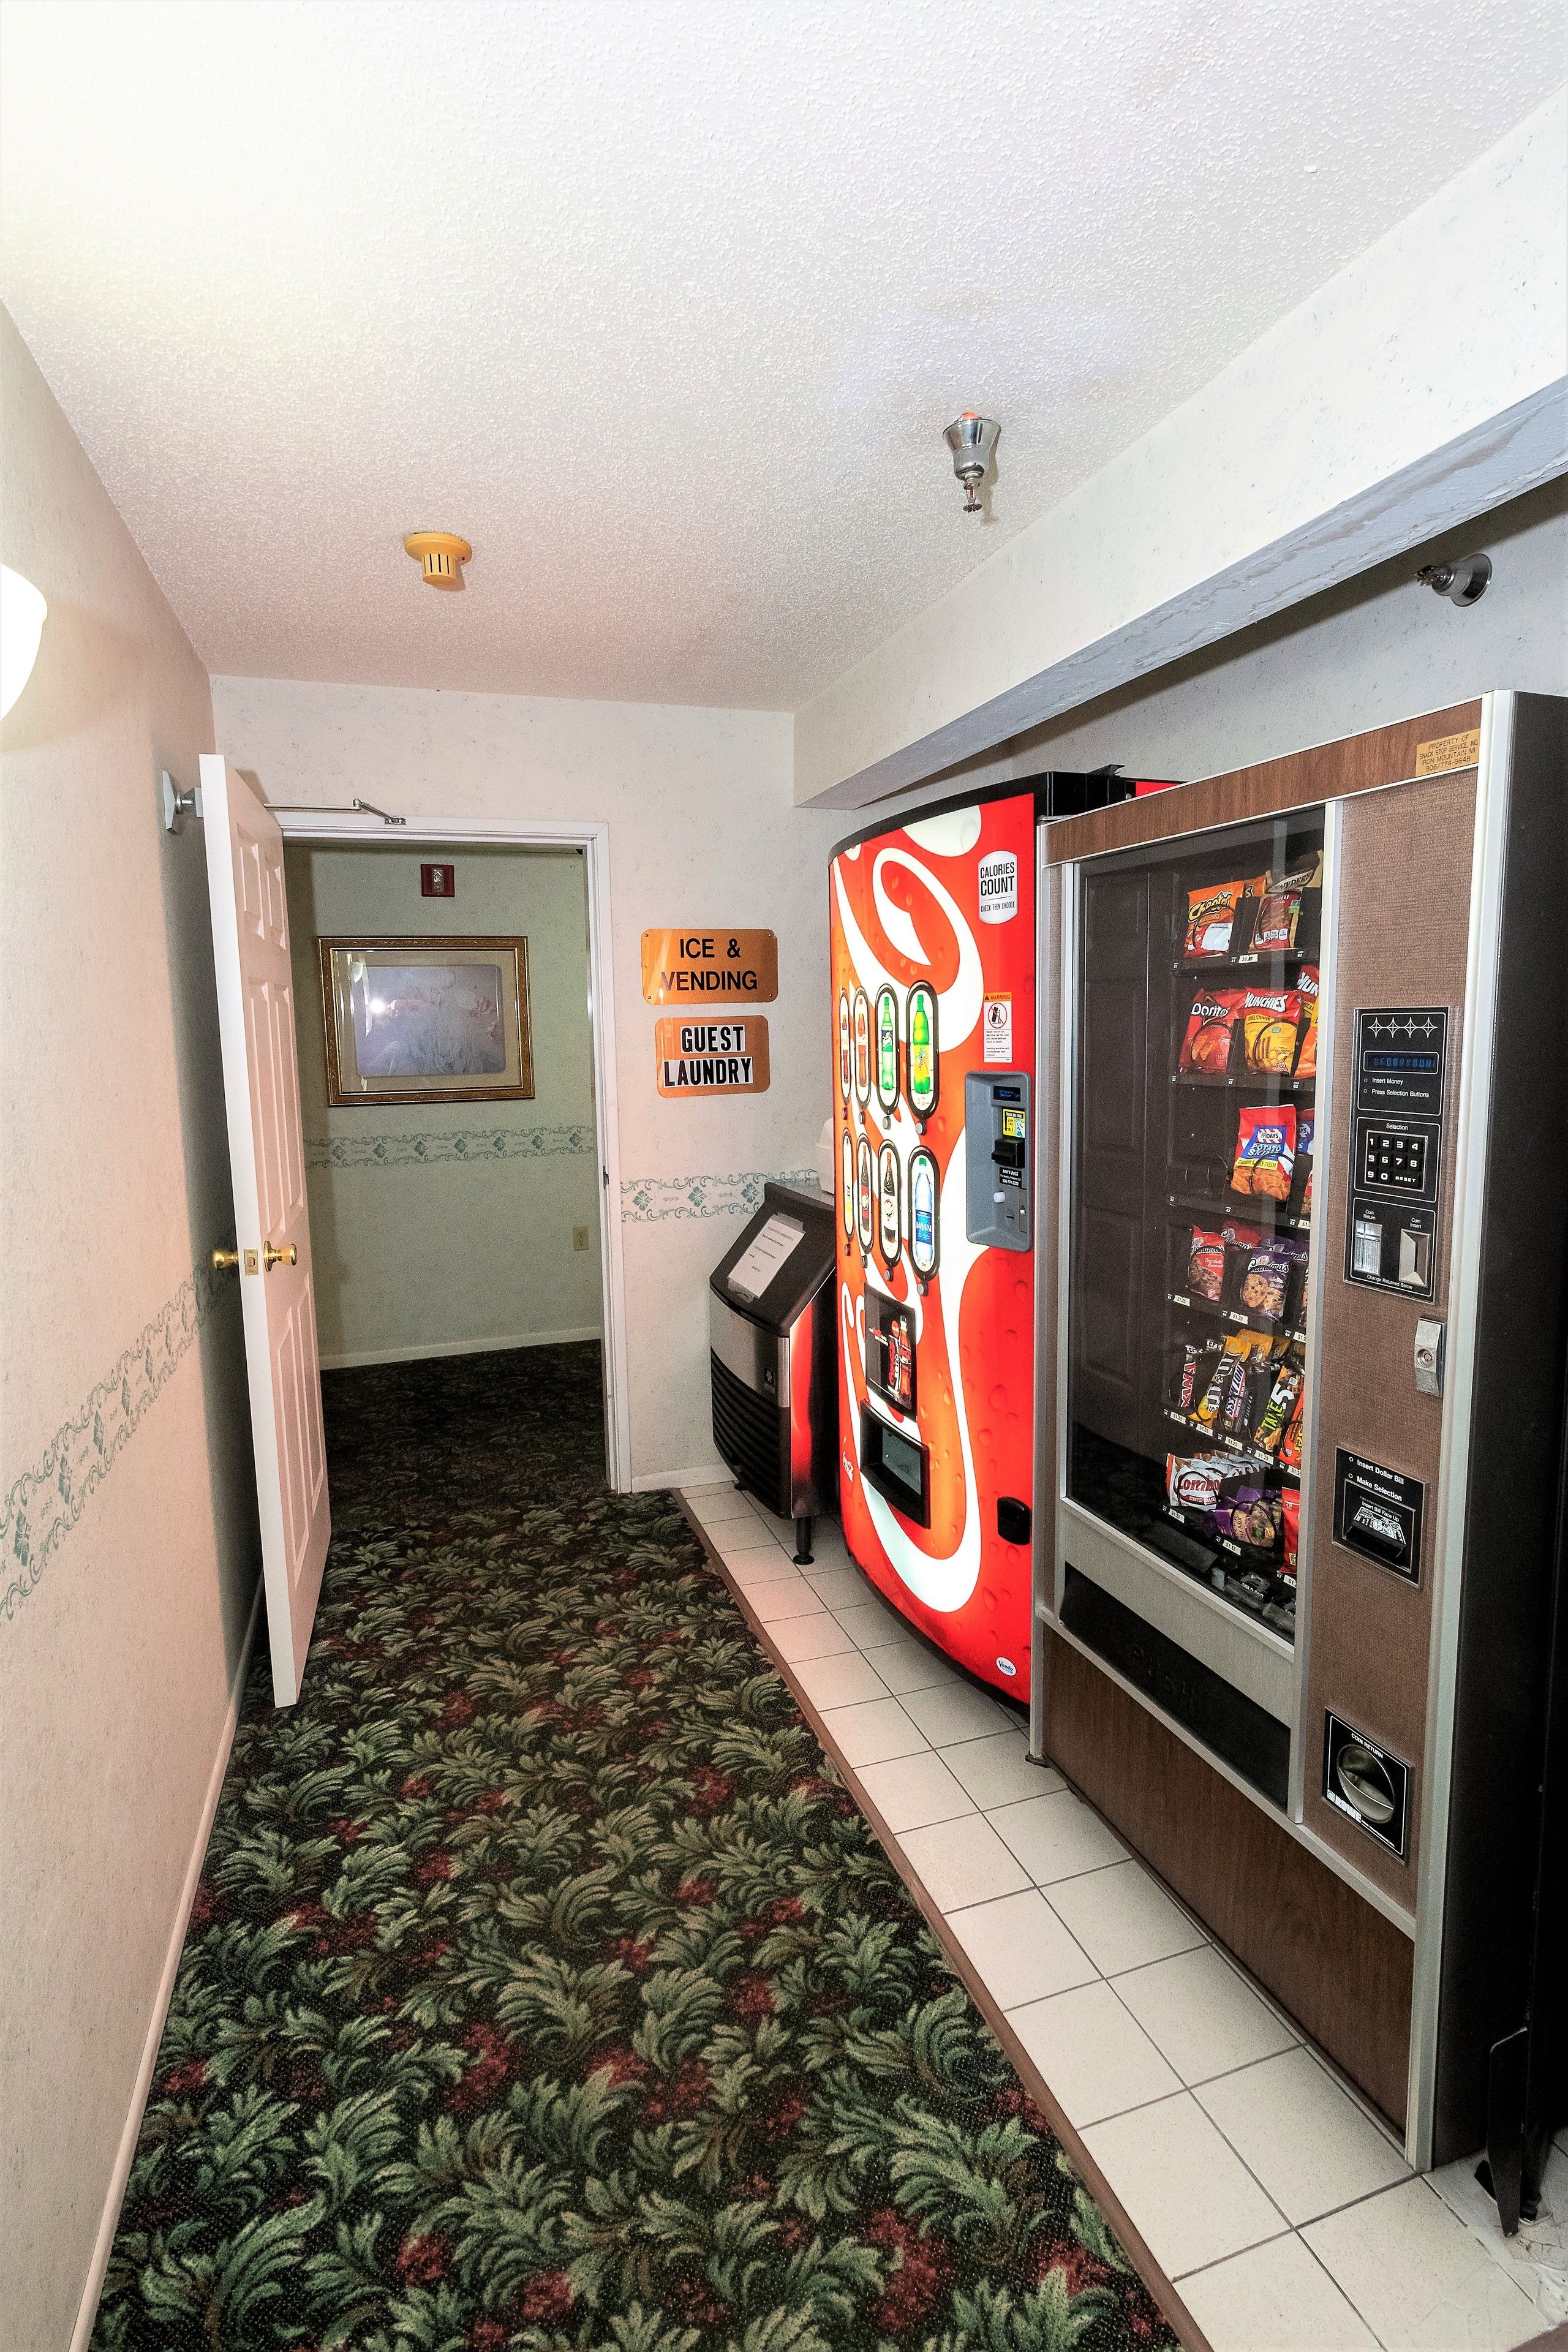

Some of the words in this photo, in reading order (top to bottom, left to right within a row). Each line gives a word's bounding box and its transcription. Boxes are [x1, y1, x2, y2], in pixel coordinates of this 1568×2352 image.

[1419, 751, 1434, 760] SNACK
[1435, 747, 1447, 756] STOP
[1428, 737, 1458, 750] PROPERTY
[1436, 750, 1467, 762] MOUNTAIN
[981, 862, 1014, 878] CALORIES
[981, 875, 1014, 896] COUNT
[1002, 901, 1015, 910] CHOOSE
[680, 938, 715, 959] ICE
[727, 938, 741, 959] &
[662, 970, 757, 990] VENDING
[1191, 1003, 1231, 1017] Doritos
[1245, 992, 1289, 1012] MUNCHIES
[682, 1027, 744, 1052] GUEST
[664, 1058, 752, 1087] LAUNDRY
[1251, 1143, 1281, 1152] POTATO
[1382, 1278, 1400, 1286] Returned
[1180, 1362, 1197, 1408] TWIX
[1271, 1382, 1294, 1409] 5
[1261, 1401, 1284, 1431] TAKE
[1357, 1459, 1373, 1472] Insert
[1375, 1466, 1393, 1480] Dollar
[1394, 1476, 1404, 1485] Bill
[1357, 1476, 1373, 1488] Make
[1374, 1481, 1402, 1501] Selection
[1362, 1501, 1374, 1510] Insert
[1382, 1510, 1392, 1518] Face
[1351, 1733, 1363, 1745] COIN
[1364, 1741, 1384, 1759] RETURN
[1335, 1795, 1361, 1823] ROWE
